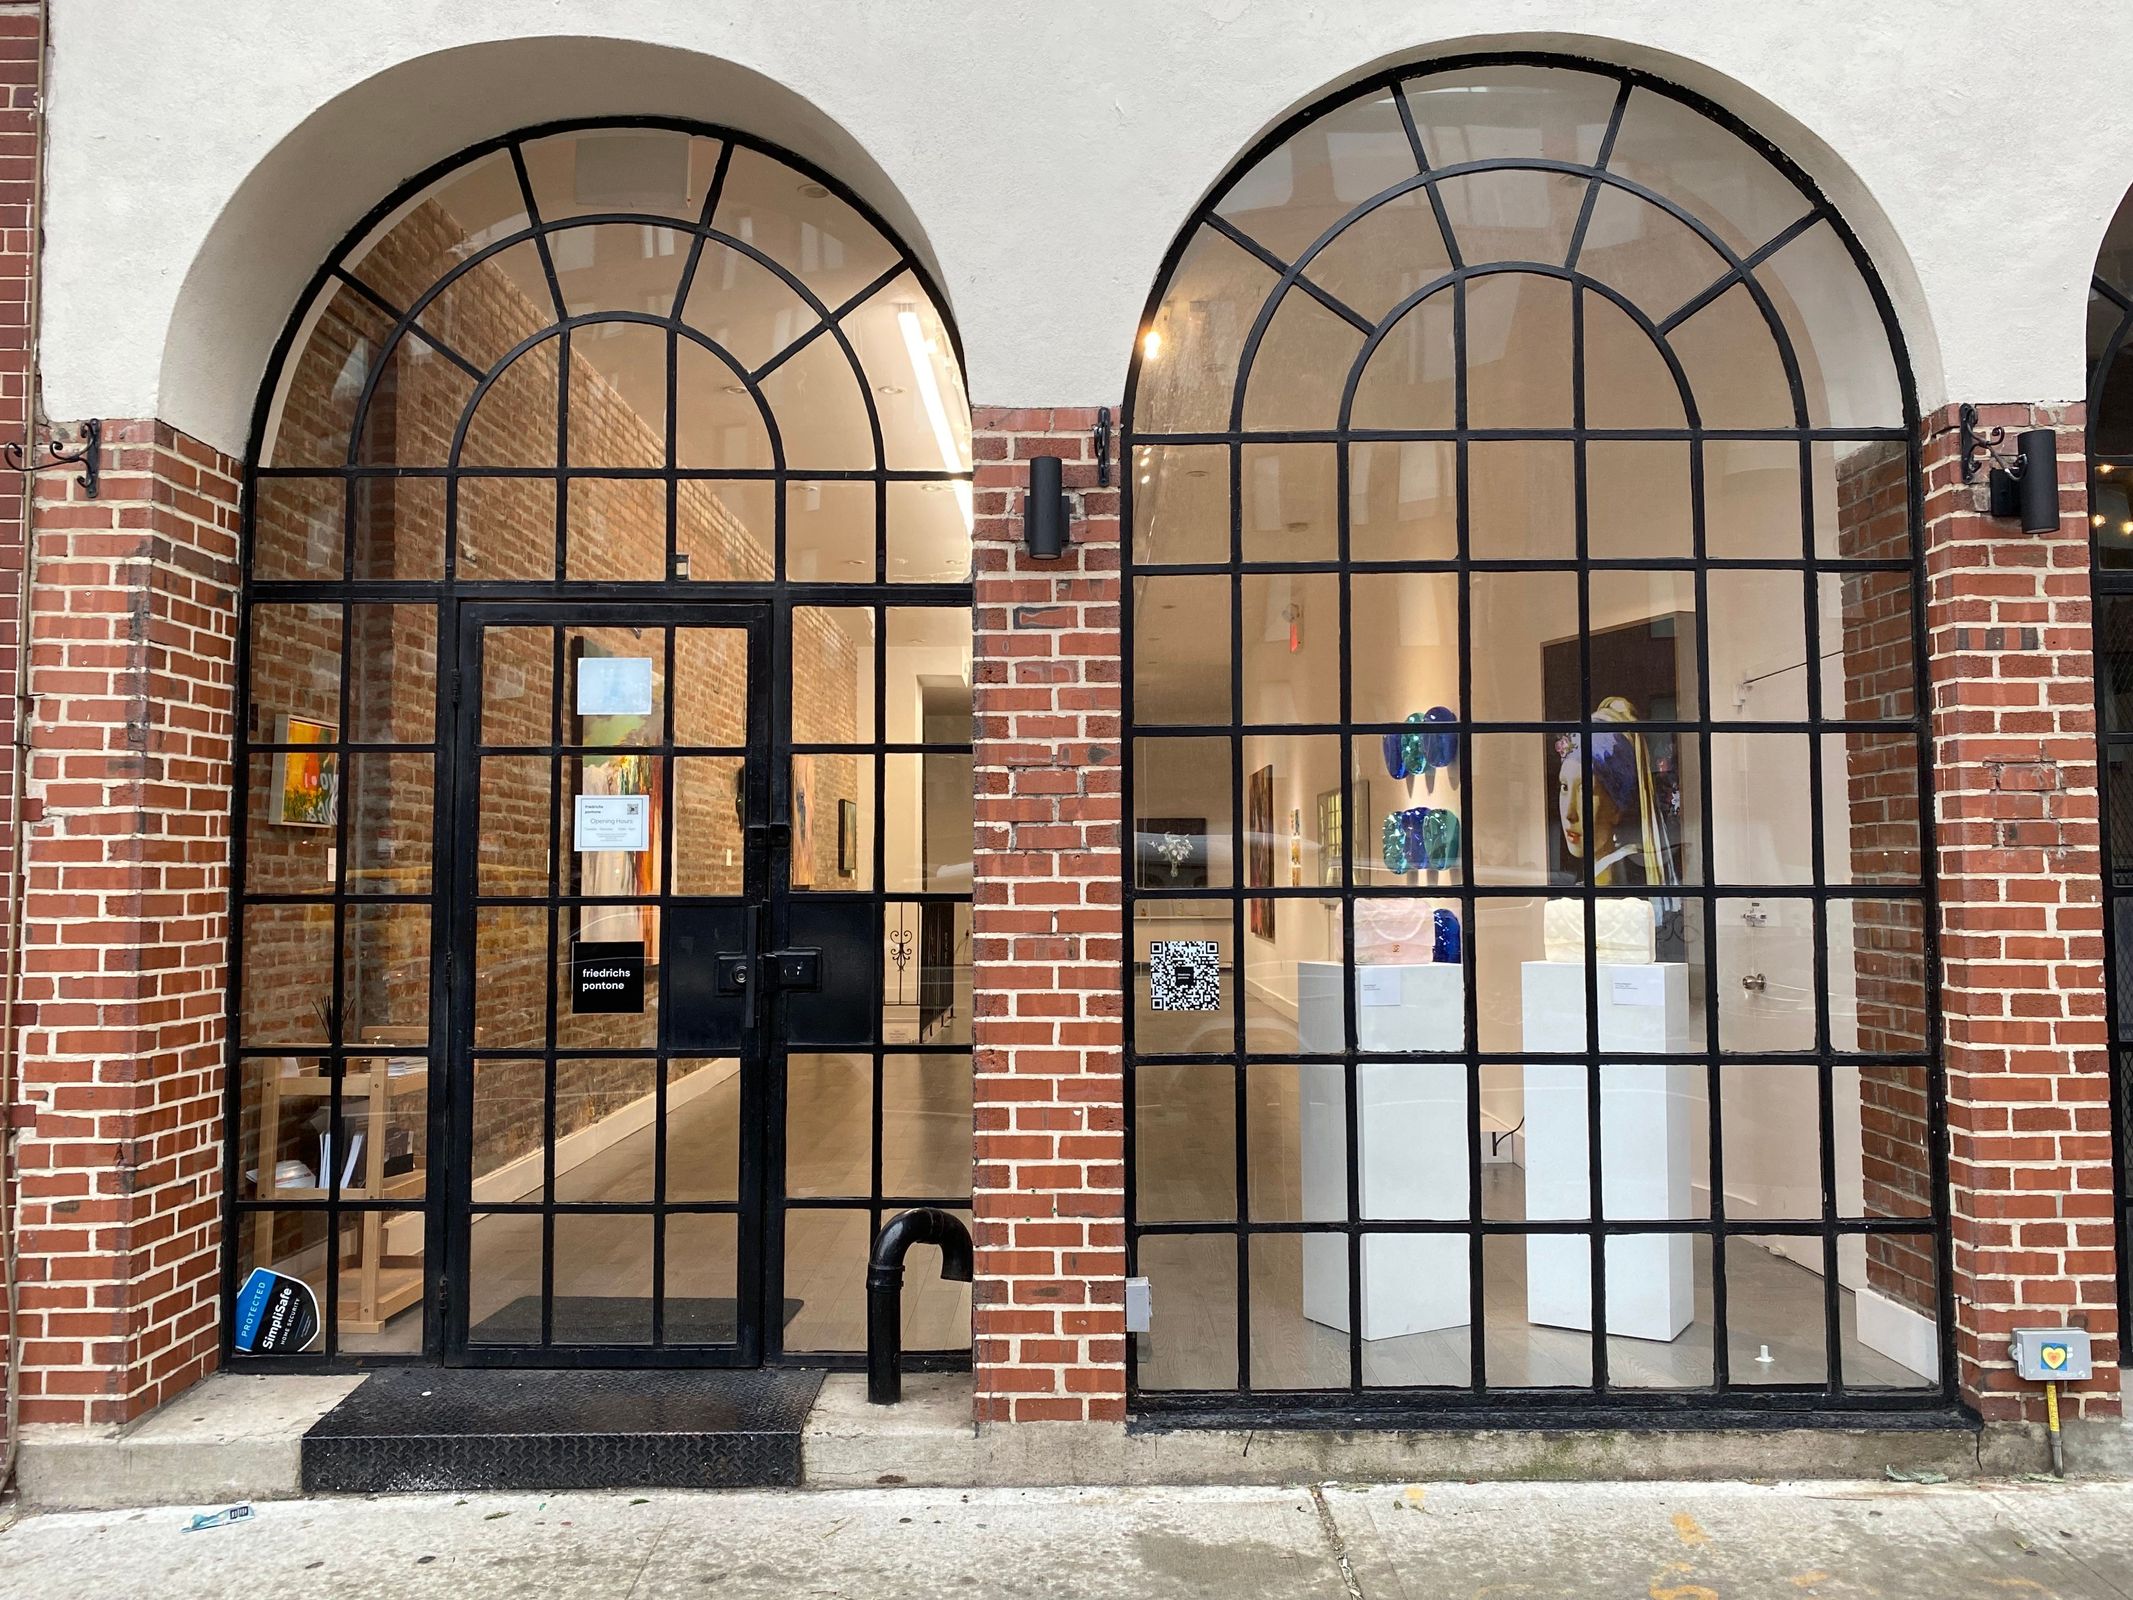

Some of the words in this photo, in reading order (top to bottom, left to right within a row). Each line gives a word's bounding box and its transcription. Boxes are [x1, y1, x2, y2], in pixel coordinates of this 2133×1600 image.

[582, 968, 631, 978] friedrichs
[582, 982, 625, 992] pontone
[241, 1282, 266, 1337] PROTECTED
[262, 1287, 292, 1350] SimpliSafe
[280, 1328, 290, 1345] HOME
[287, 1298, 301, 1327] SECURITY
